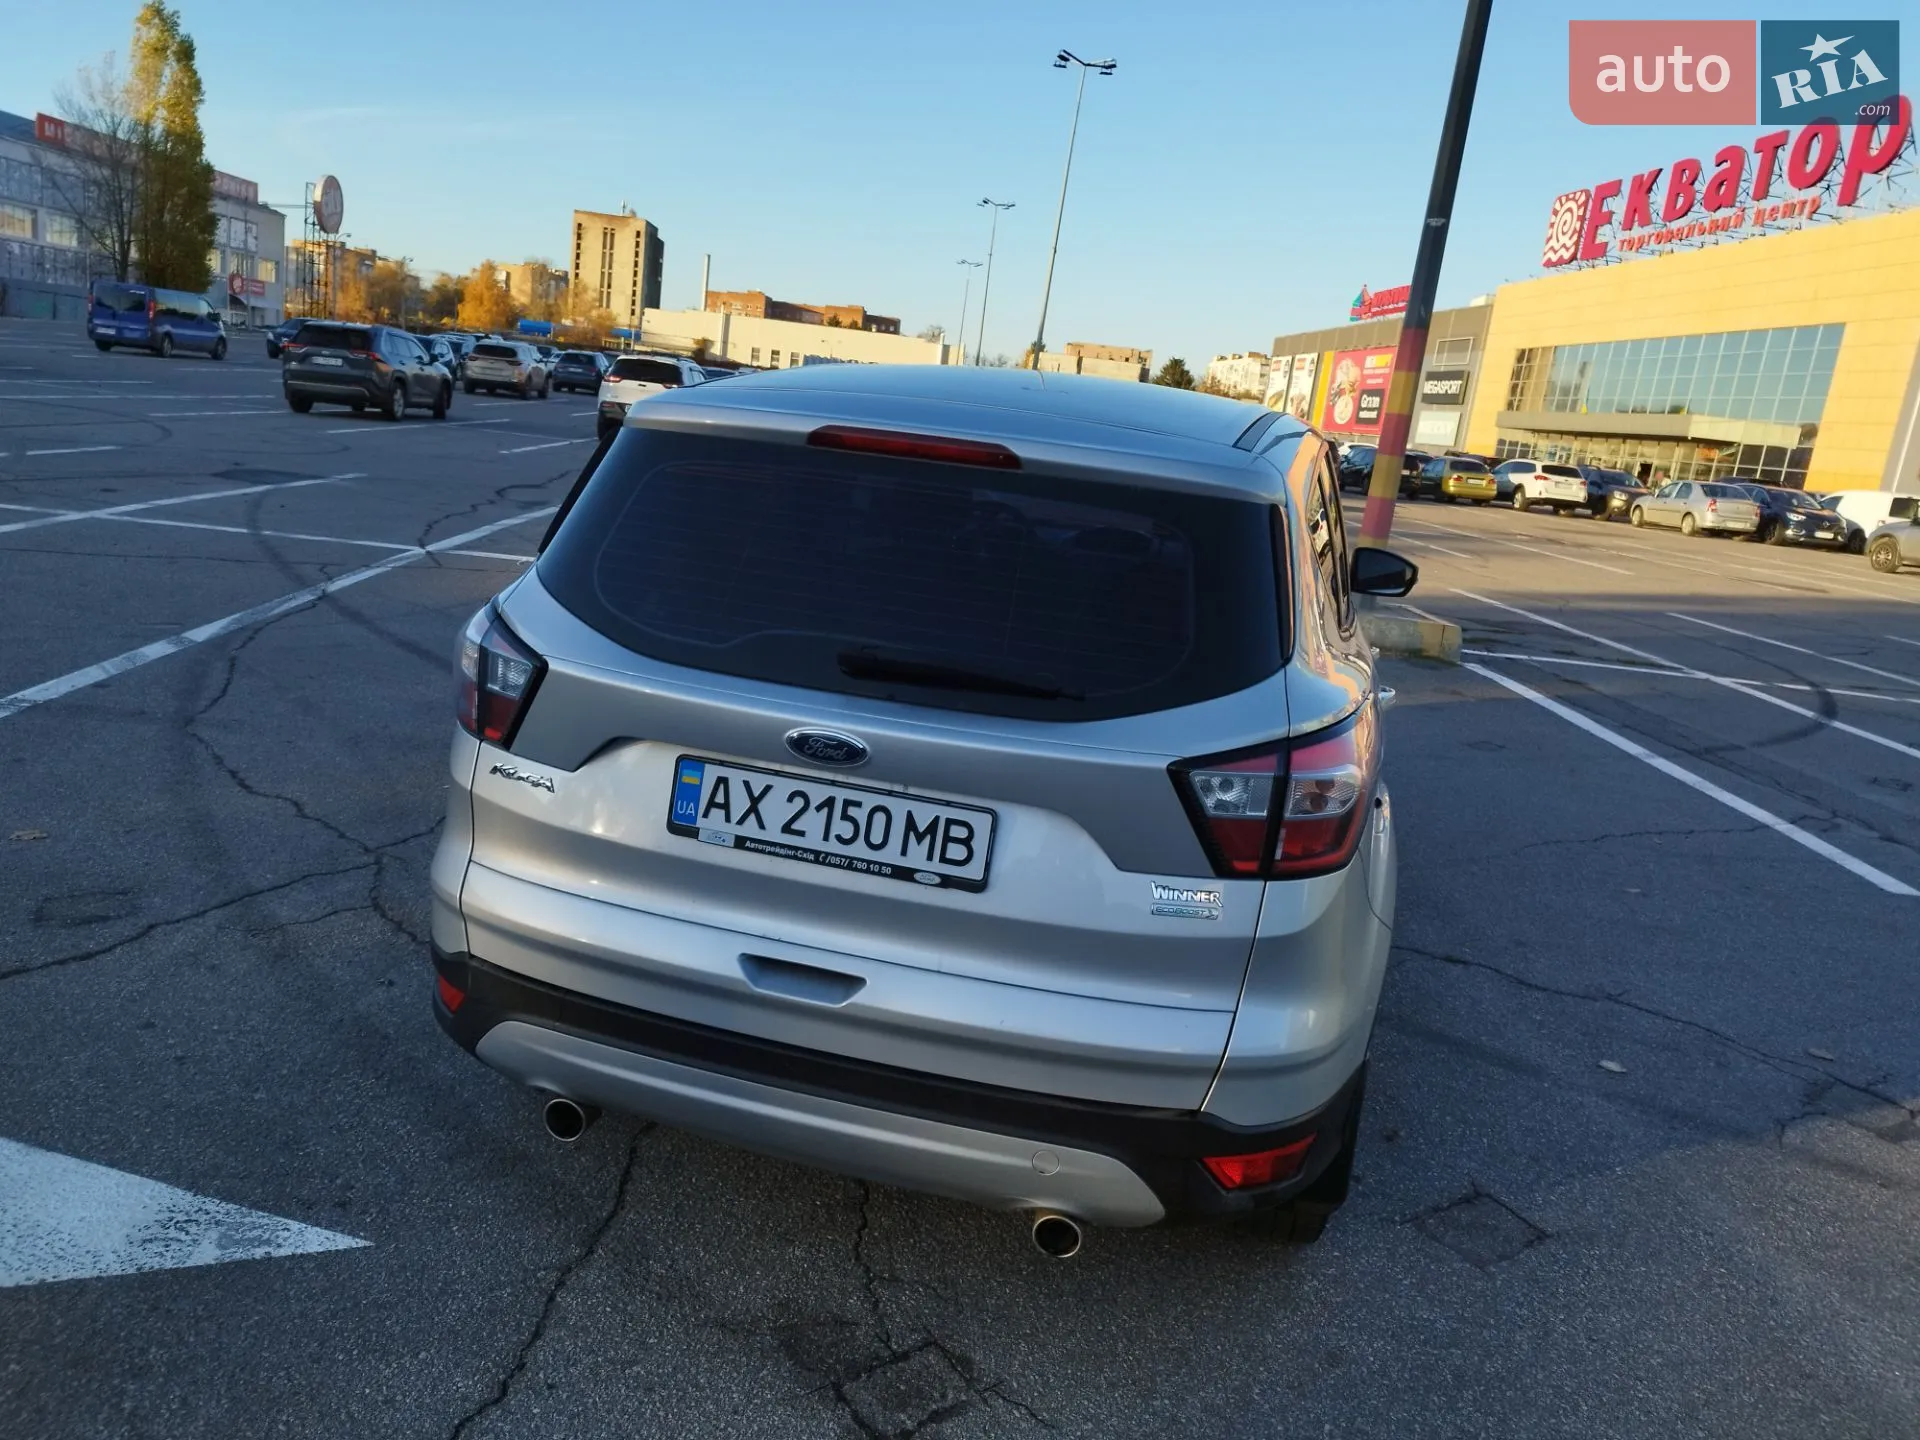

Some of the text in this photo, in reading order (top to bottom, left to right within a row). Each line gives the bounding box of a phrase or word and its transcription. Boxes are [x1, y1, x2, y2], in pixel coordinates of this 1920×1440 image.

[1751, 196, 1822, 227] центр
[1423, 380, 1463, 394] MEGASPORT
[803, 736, 849, 762] Ford
[677, 799, 696, 817] UA
[702, 775, 975, 867] AX 2150 MB
[851, 860, 867, 870] 760
[869, 863, 879, 873] 10
[880, 865, 892, 875] 50
[1151, 880, 1223, 907] WINNER
